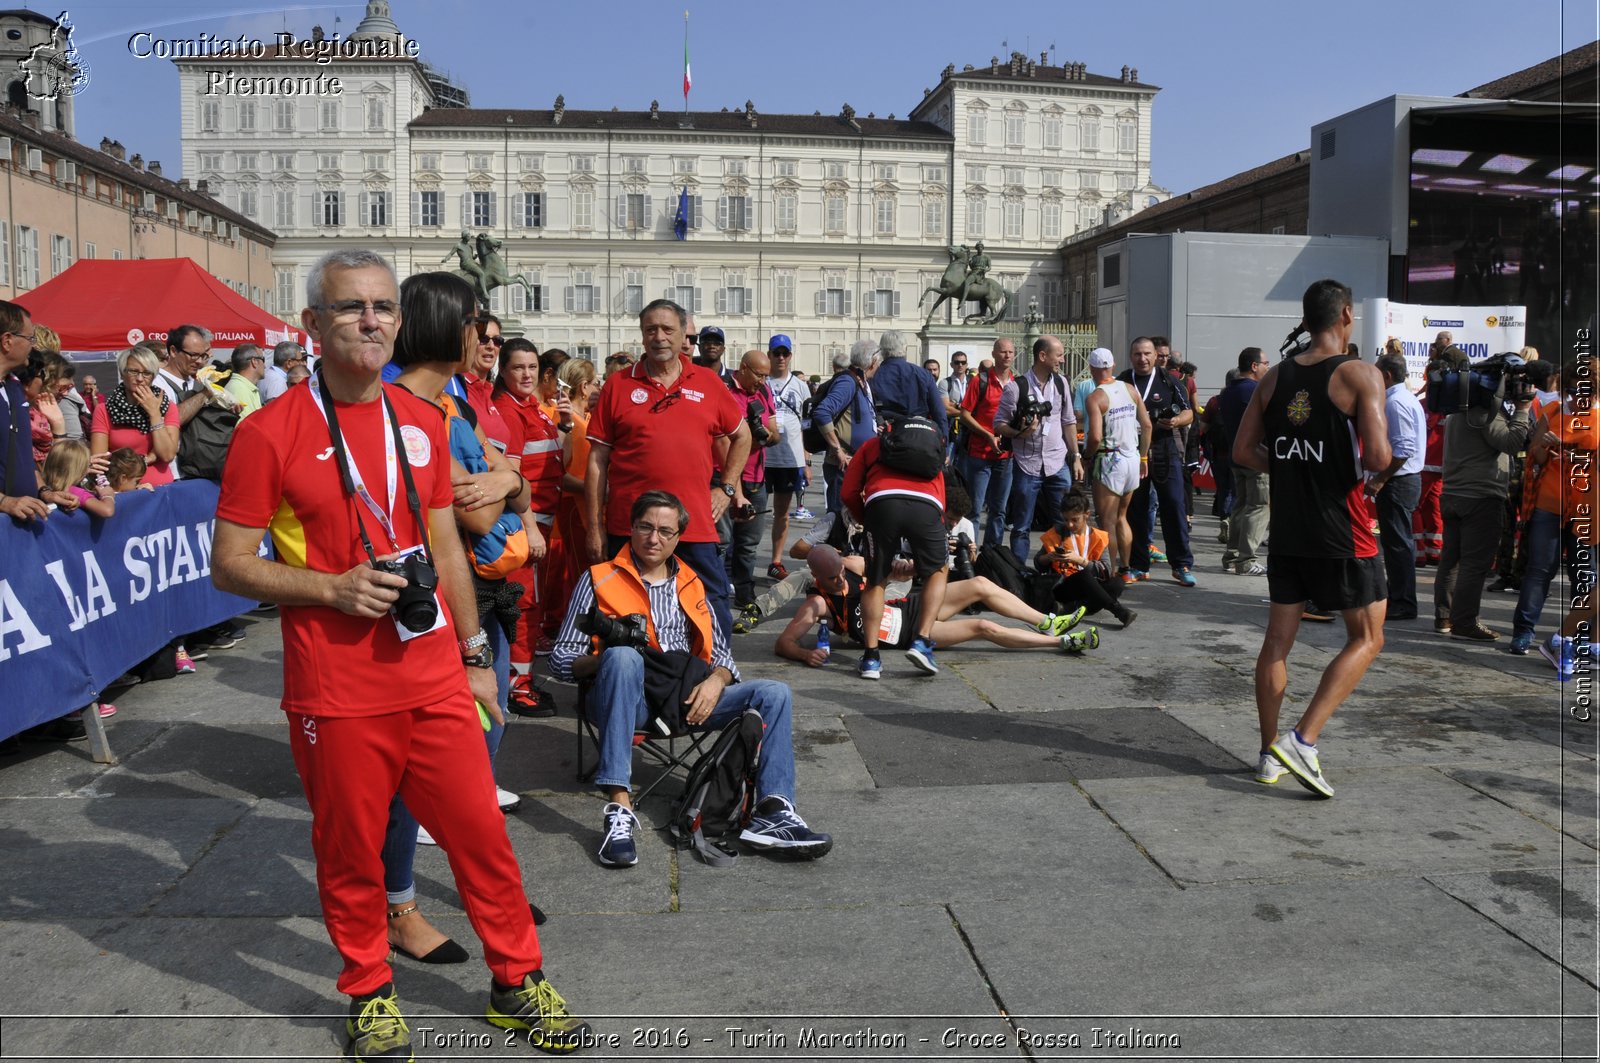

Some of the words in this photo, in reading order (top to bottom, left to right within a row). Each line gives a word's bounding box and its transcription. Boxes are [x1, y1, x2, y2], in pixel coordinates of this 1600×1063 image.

[148, 332, 169, 341] CRO
[214, 333, 255, 341] ITALIANA
[1401, 341, 1416, 357] RIN
[1274, 436, 1324, 463] CAN
[45, 550, 117, 632] LA
